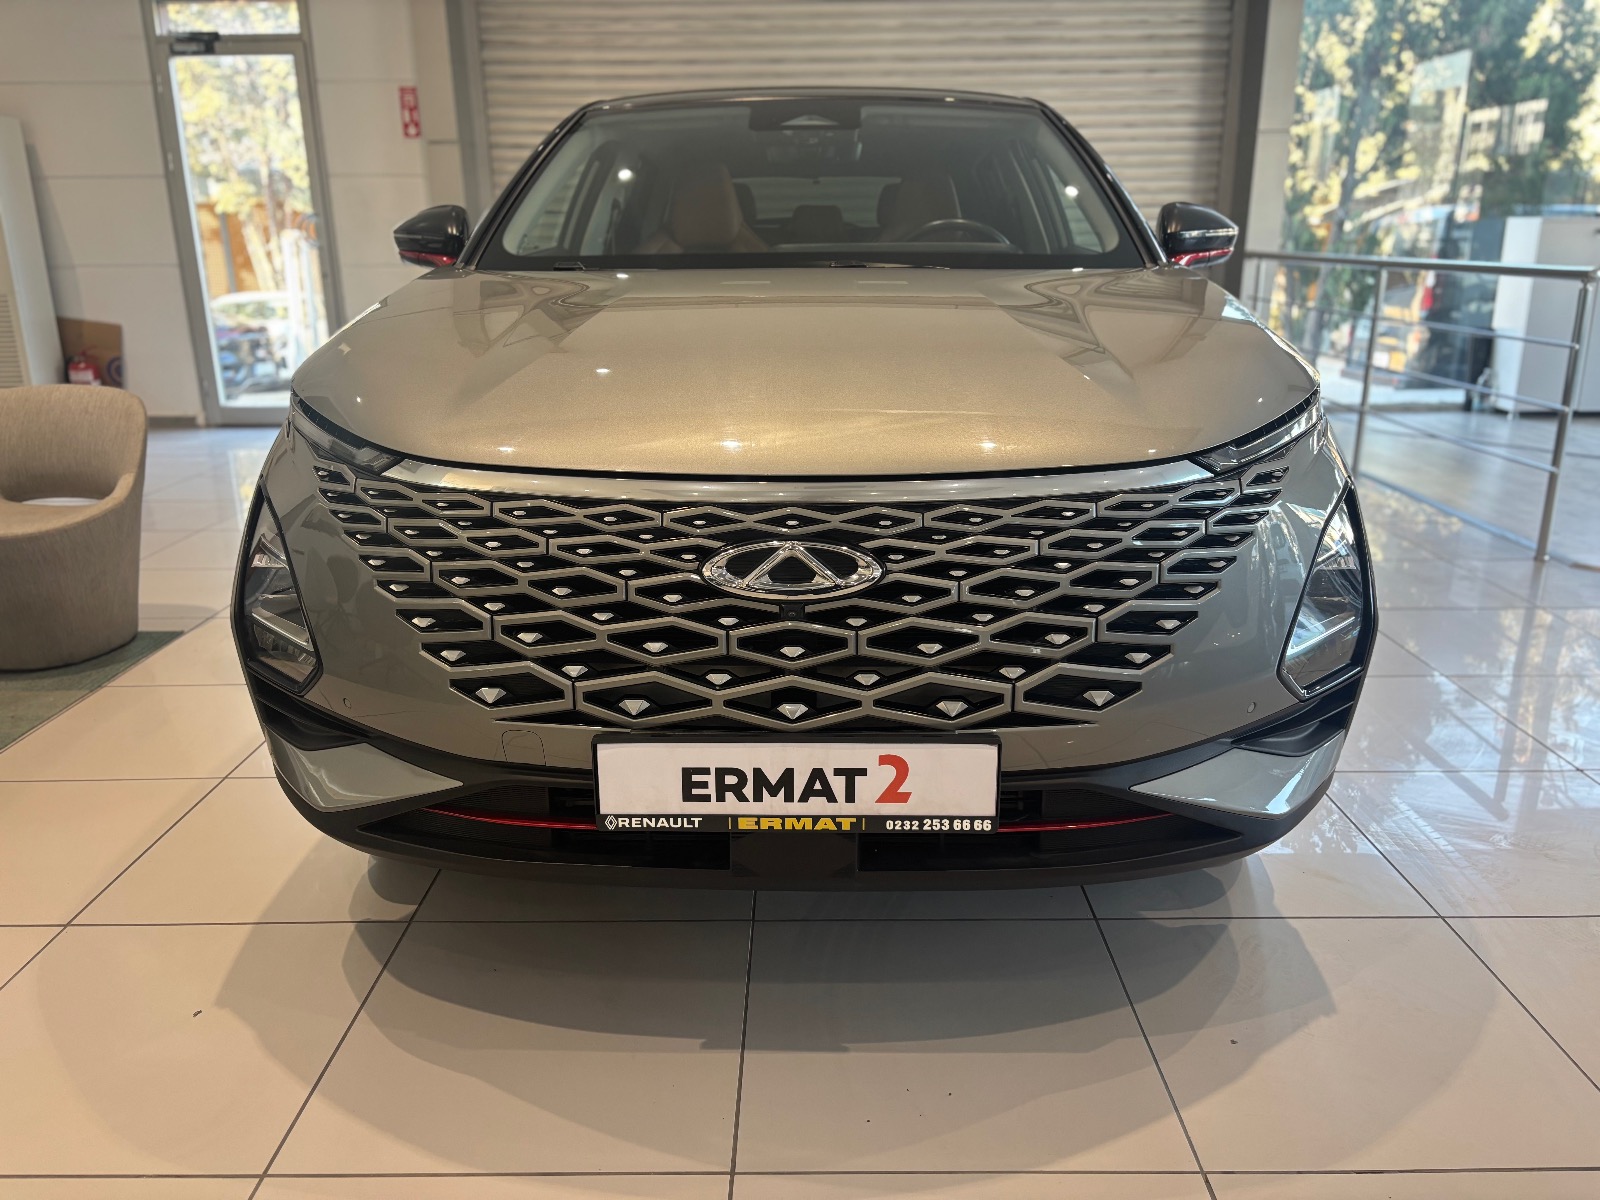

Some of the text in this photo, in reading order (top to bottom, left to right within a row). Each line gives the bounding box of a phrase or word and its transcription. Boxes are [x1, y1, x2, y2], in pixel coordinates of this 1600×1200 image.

[681, 754, 913, 804] ERMAT 2
[618, 817, 992, 831] RENAULT ERMAT 0232 253 66 66
